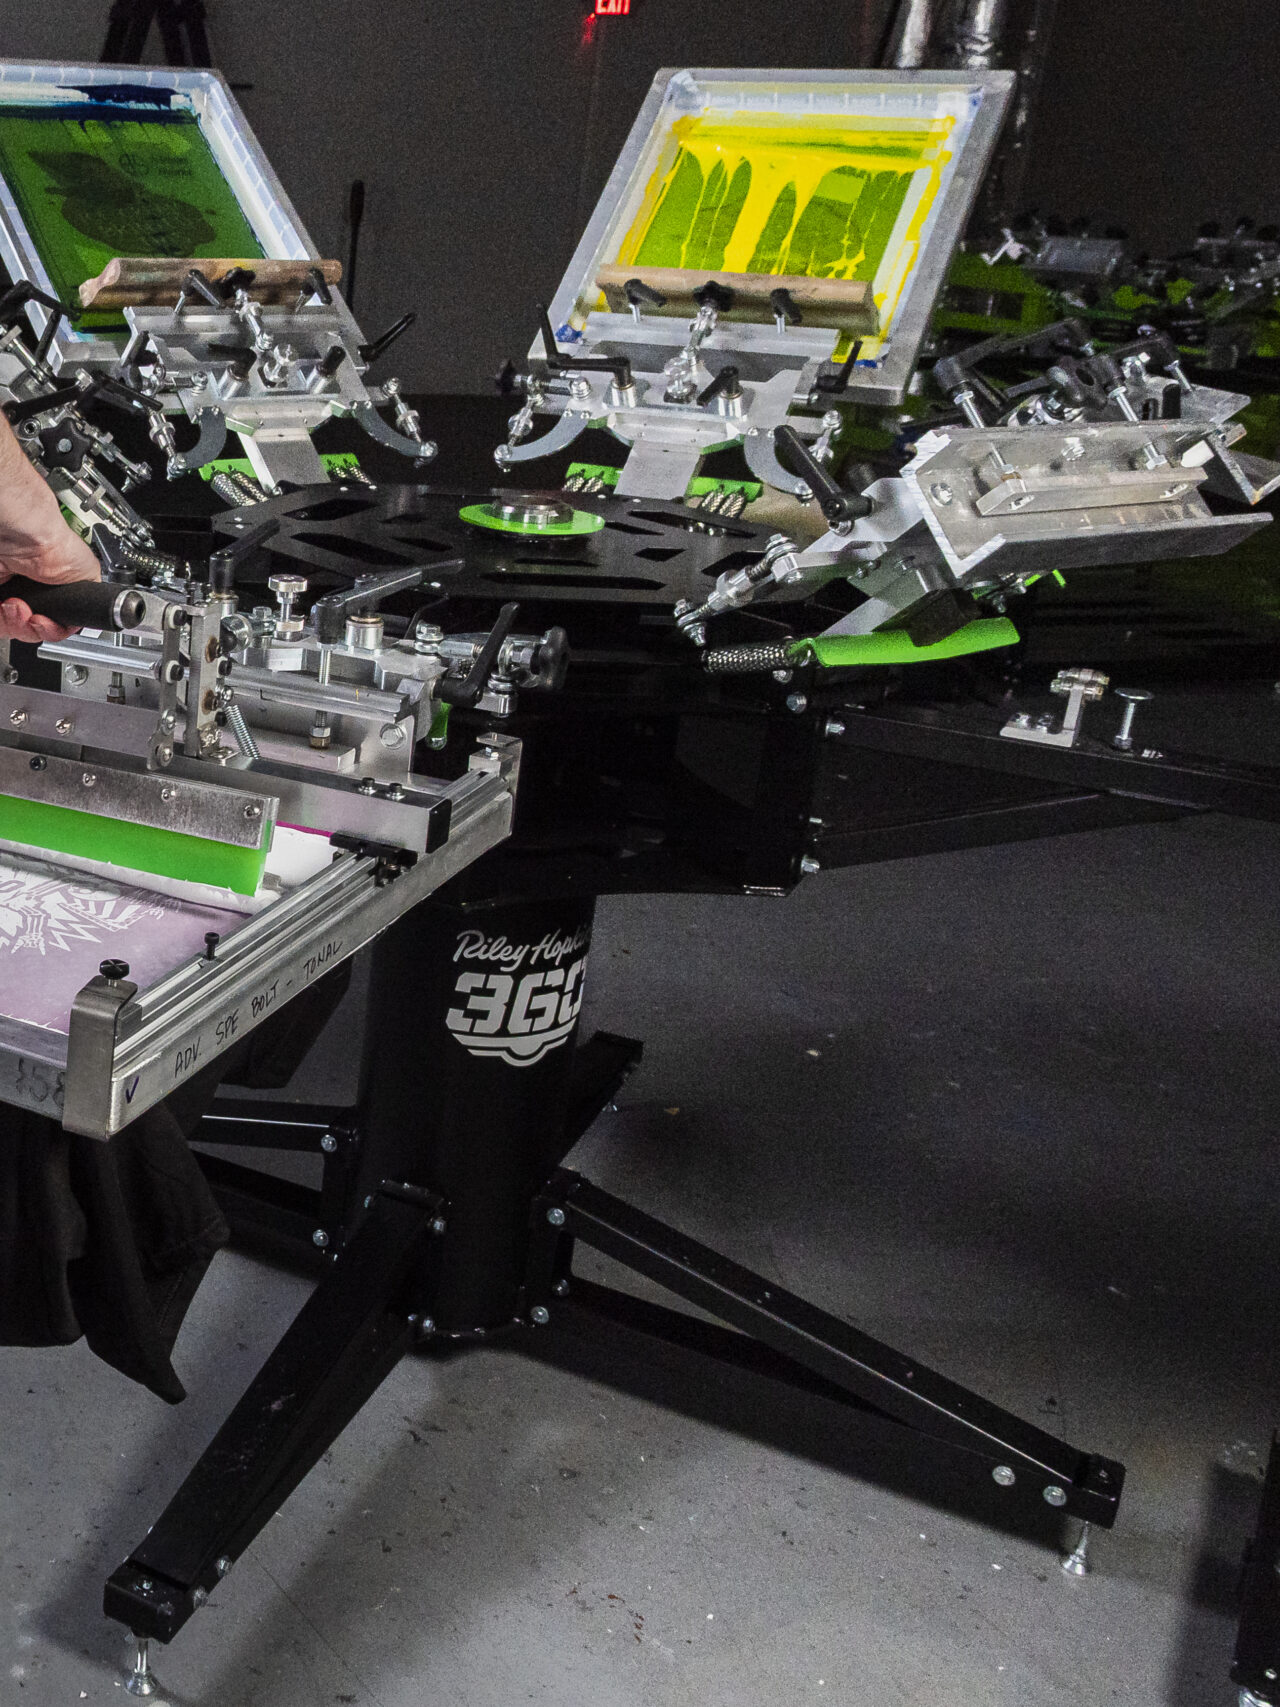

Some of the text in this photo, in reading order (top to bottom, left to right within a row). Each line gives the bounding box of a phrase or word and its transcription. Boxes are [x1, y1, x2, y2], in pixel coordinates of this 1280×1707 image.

[303, 941, 343, 979] TONAL
[453, 930, 531, 972] Riley
[445, 955, 586, 1034] 360
